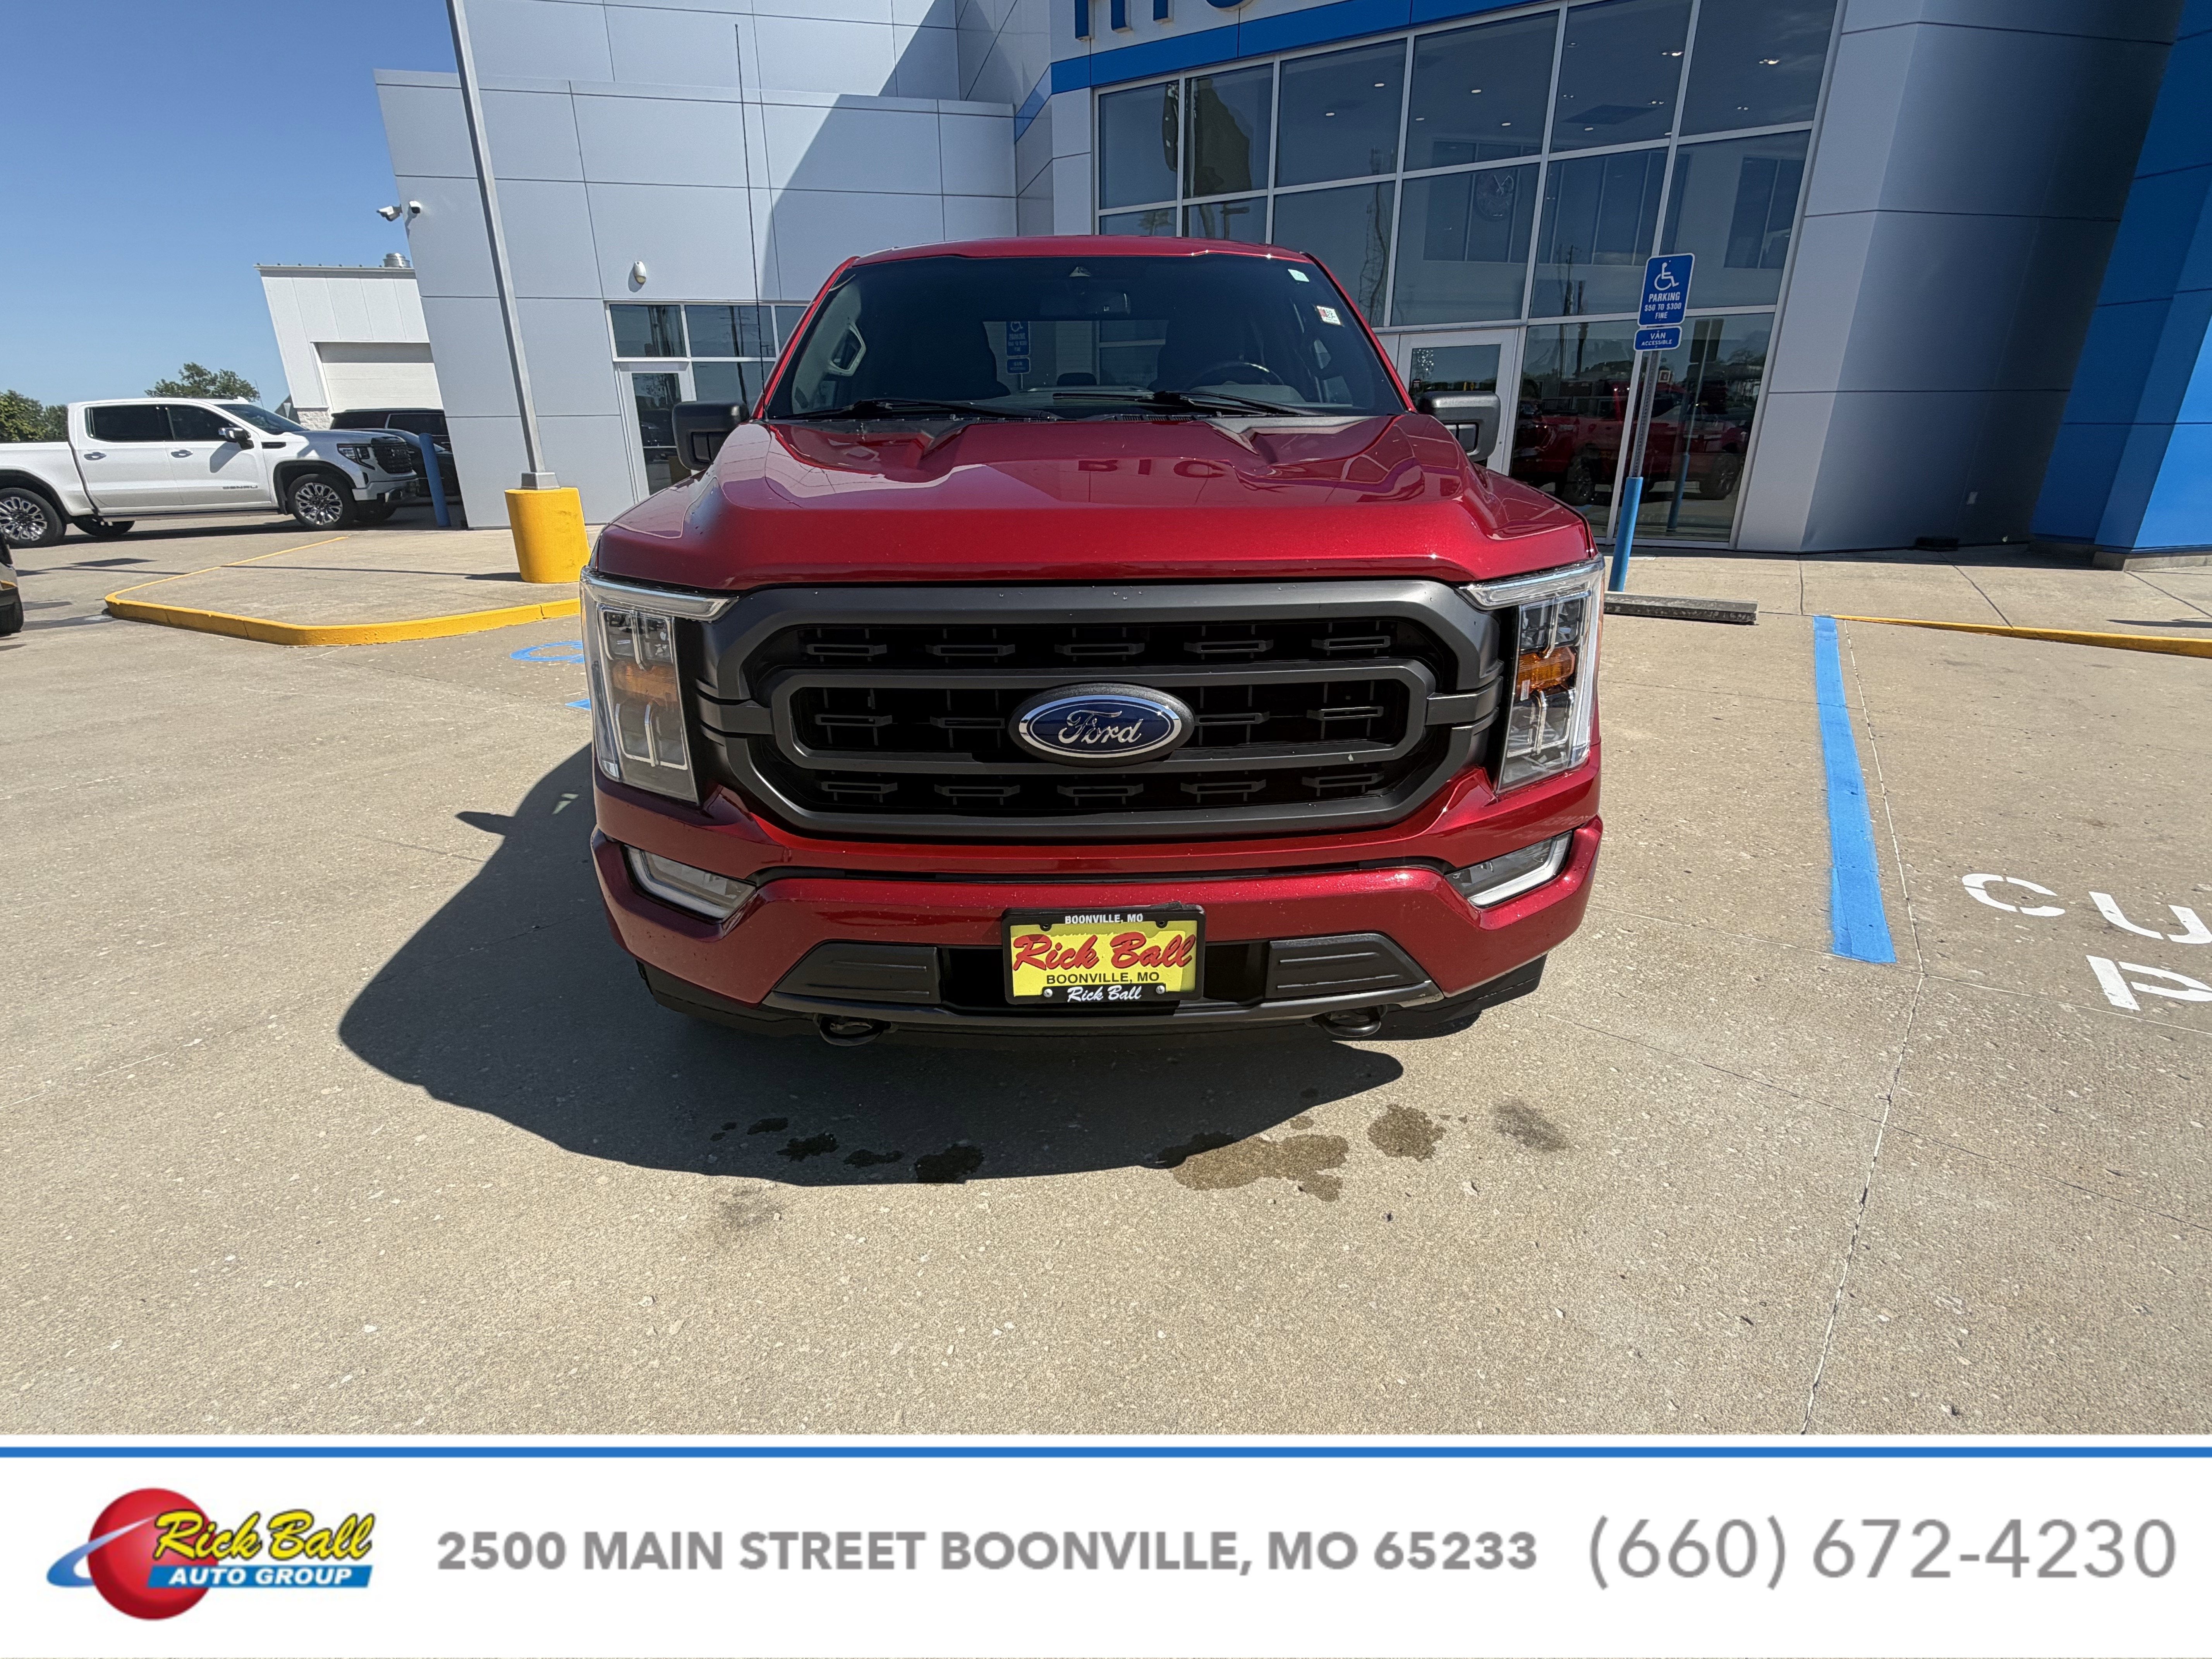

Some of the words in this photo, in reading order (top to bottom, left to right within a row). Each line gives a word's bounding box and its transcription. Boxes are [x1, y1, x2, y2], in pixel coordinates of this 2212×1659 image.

[1648, 292, 1681, 302] PARKING
[1058, 709, 1144, 744] Ford
[1065, 914, 1123, 924] BOONVILLE,
[1127, 913, 1143, 922] MO
[1013, 934, 1099, 971] Rick
[1109, 931, 1196, 968] Ball
[1046, 972, 1132, 984] BOONVILLE,
[1137, 972, 1160, 982] MO
[1067, 987, 1103, 1002] Rick
[1108, 986, 1142, 1000] Ball
